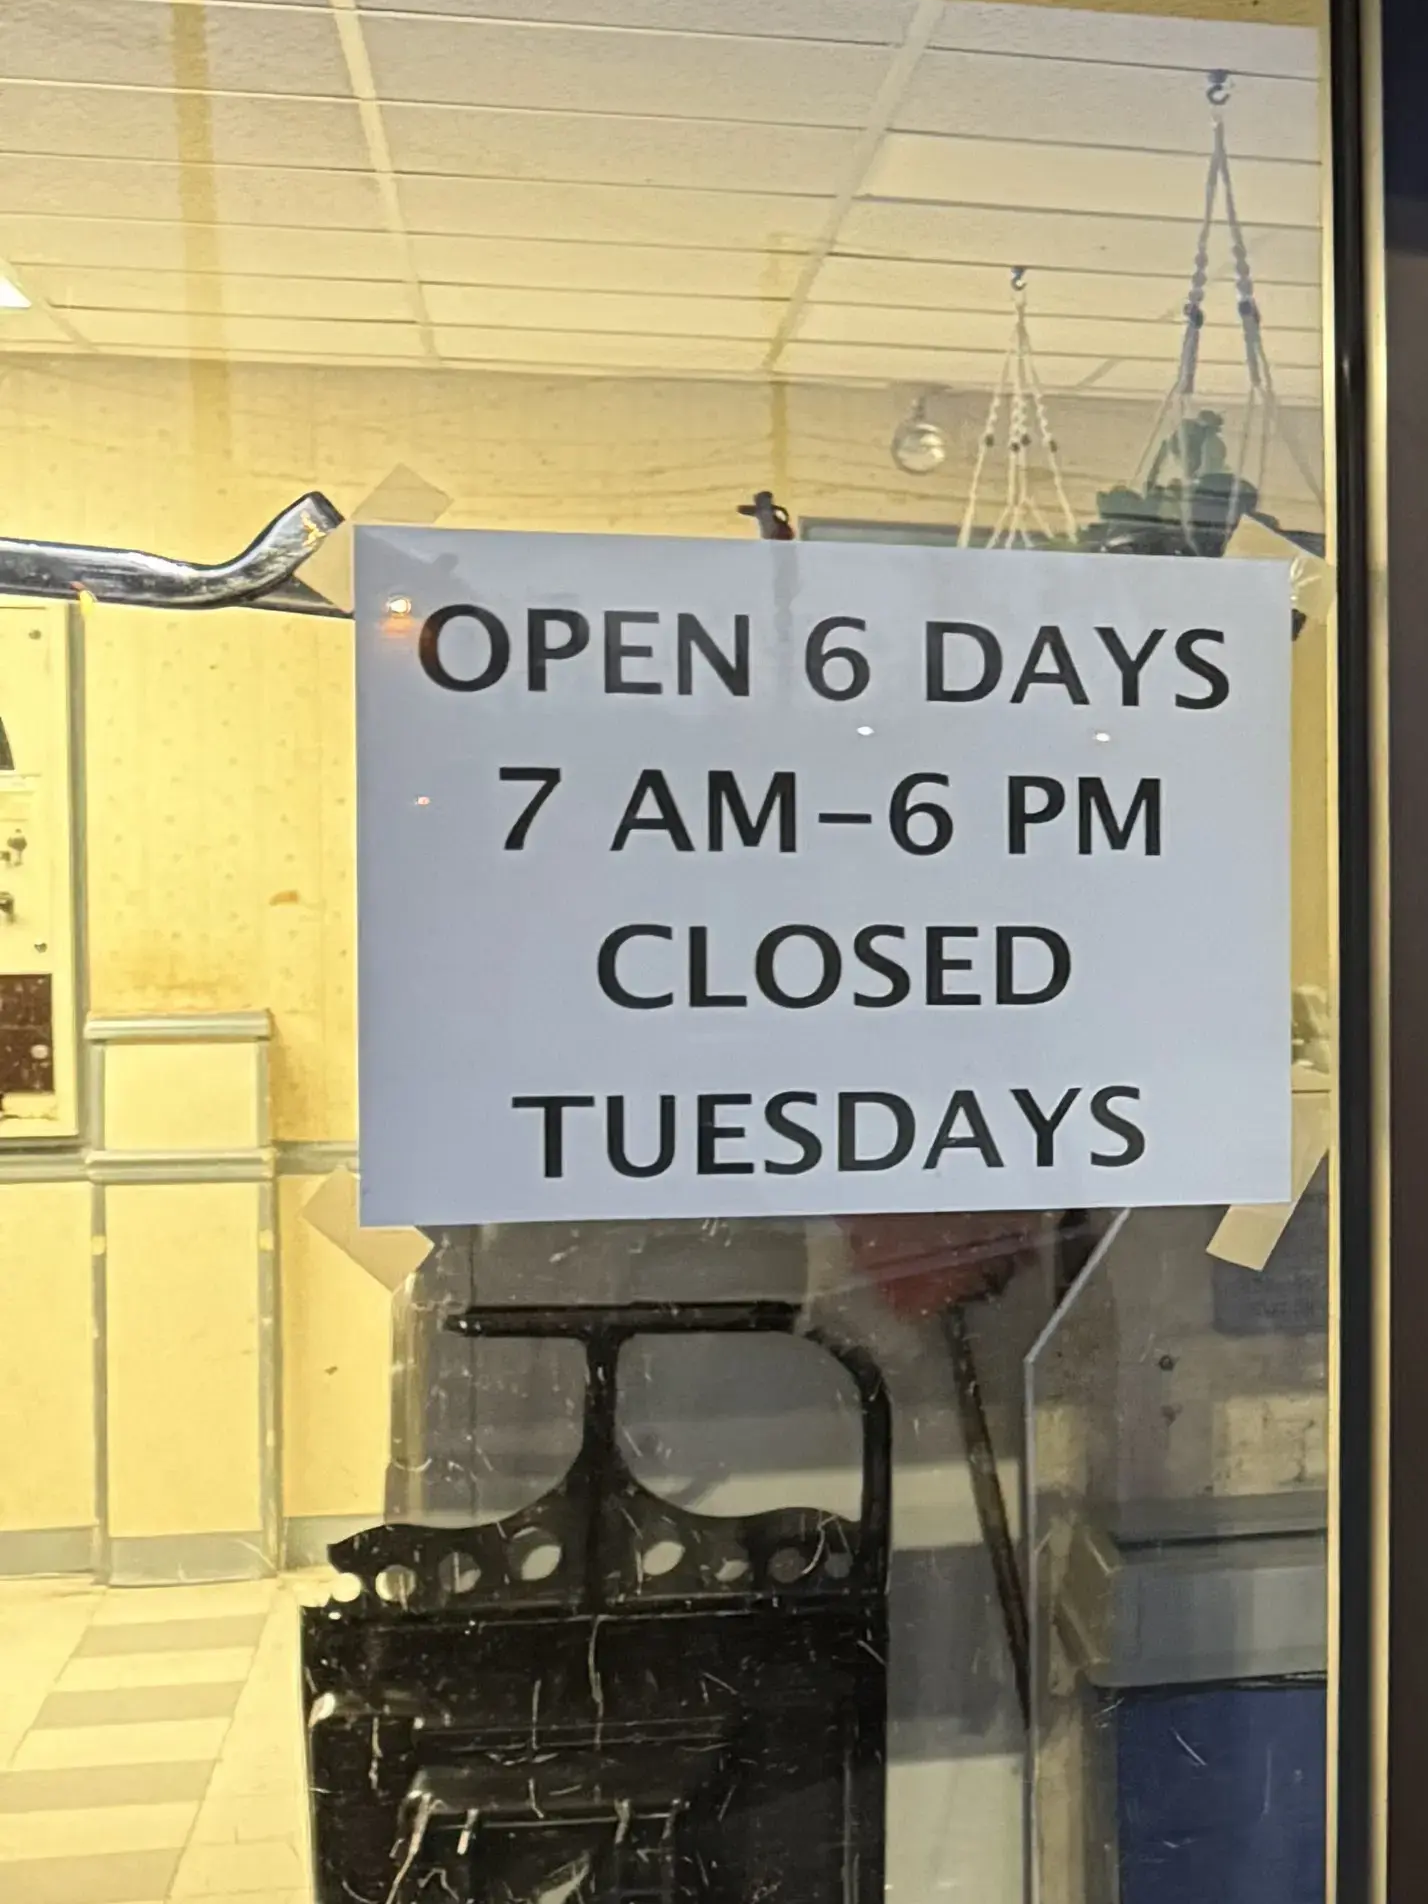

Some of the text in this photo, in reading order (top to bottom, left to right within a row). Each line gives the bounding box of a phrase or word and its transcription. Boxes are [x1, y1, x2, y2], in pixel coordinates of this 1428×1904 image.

[417, 603, 1231, 711] OPEN 6 DAYS
[498, 765, 562, 852] 7
[1007, 774, 1162, 857] PM
[596, 922, 1072, 1011] CLOSED
[510, 1084, 1146, 1180] TUESDAYS
